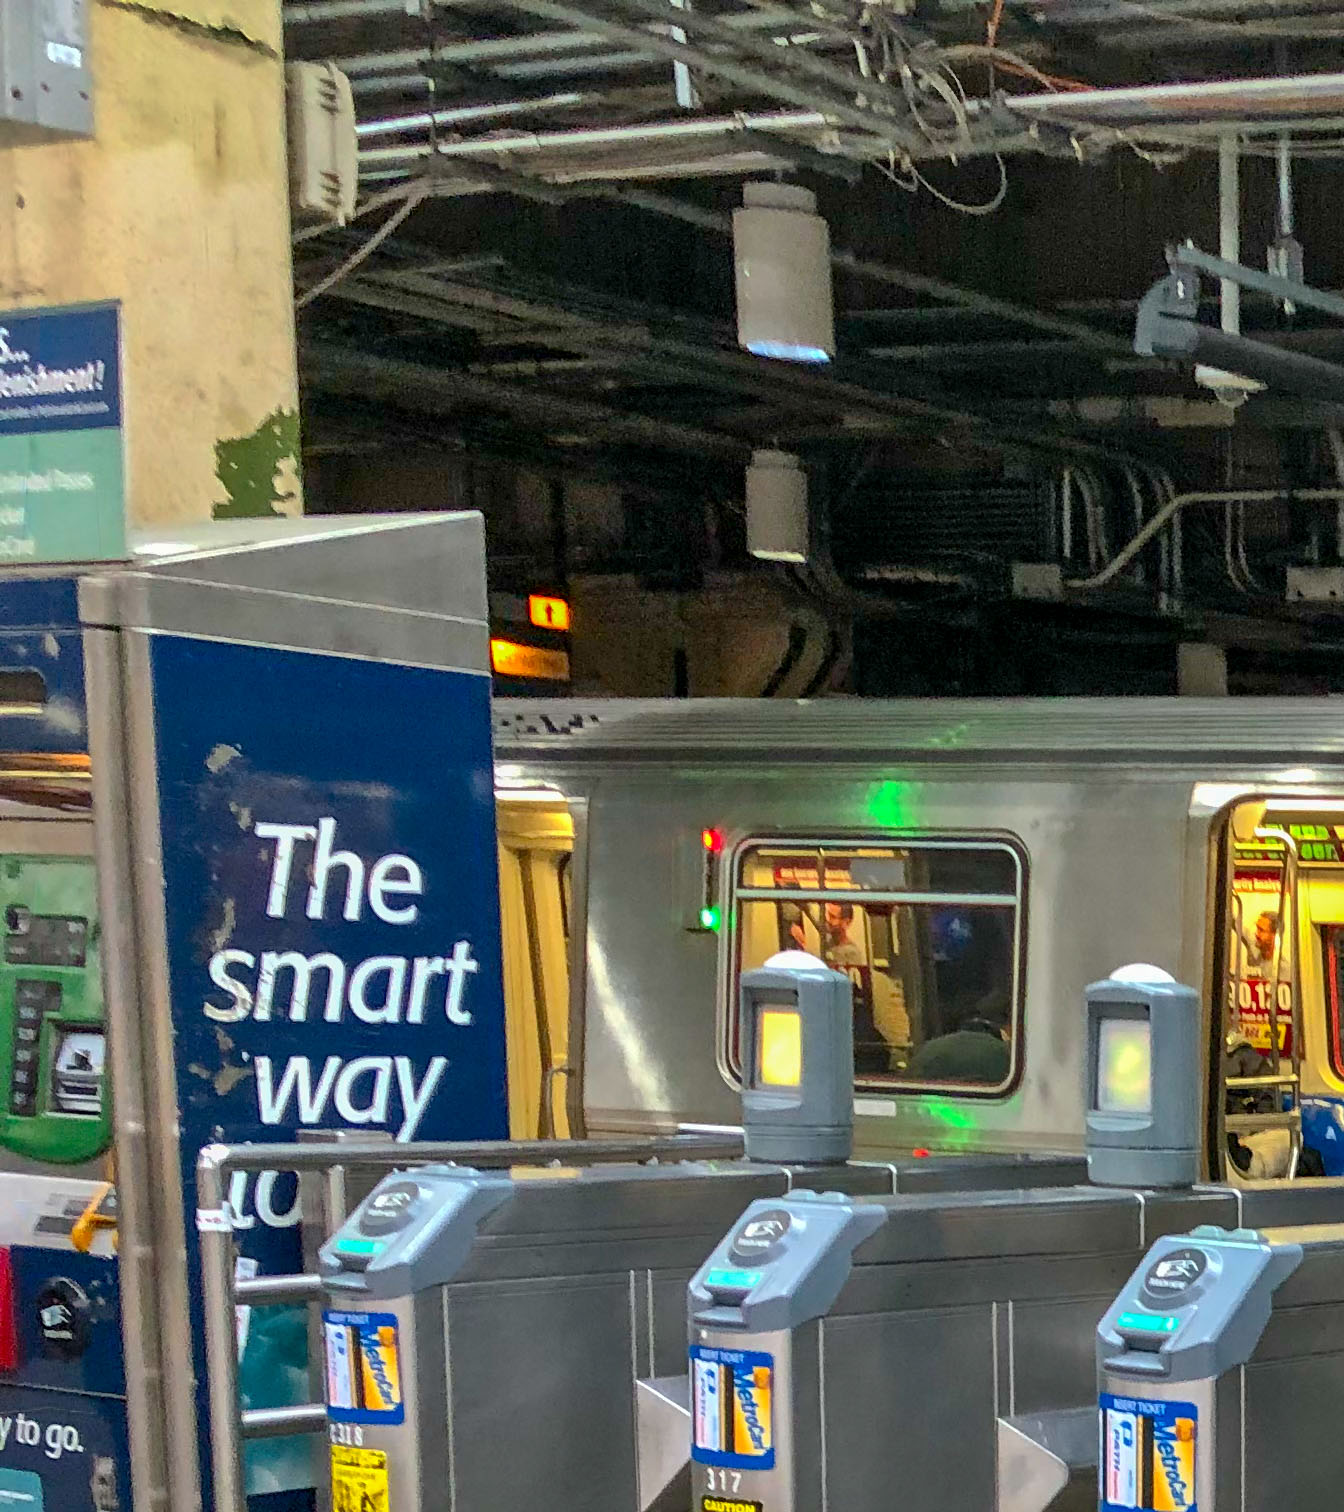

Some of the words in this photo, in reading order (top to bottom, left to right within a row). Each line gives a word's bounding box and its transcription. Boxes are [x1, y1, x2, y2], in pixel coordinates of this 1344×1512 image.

[255, 816, 423, 925] The
[203, 940, 479, 1027] smart
[254, 1054, 450, 1143] way
[1138, 1402, 1166, 1416] TICKET
[15, 1412, 41, 1446] to
[45, 1423, 84, 1459] go.
[1113, 1428, 1121, 1472] PATH
[706, 1467, 742, 1493] 317
